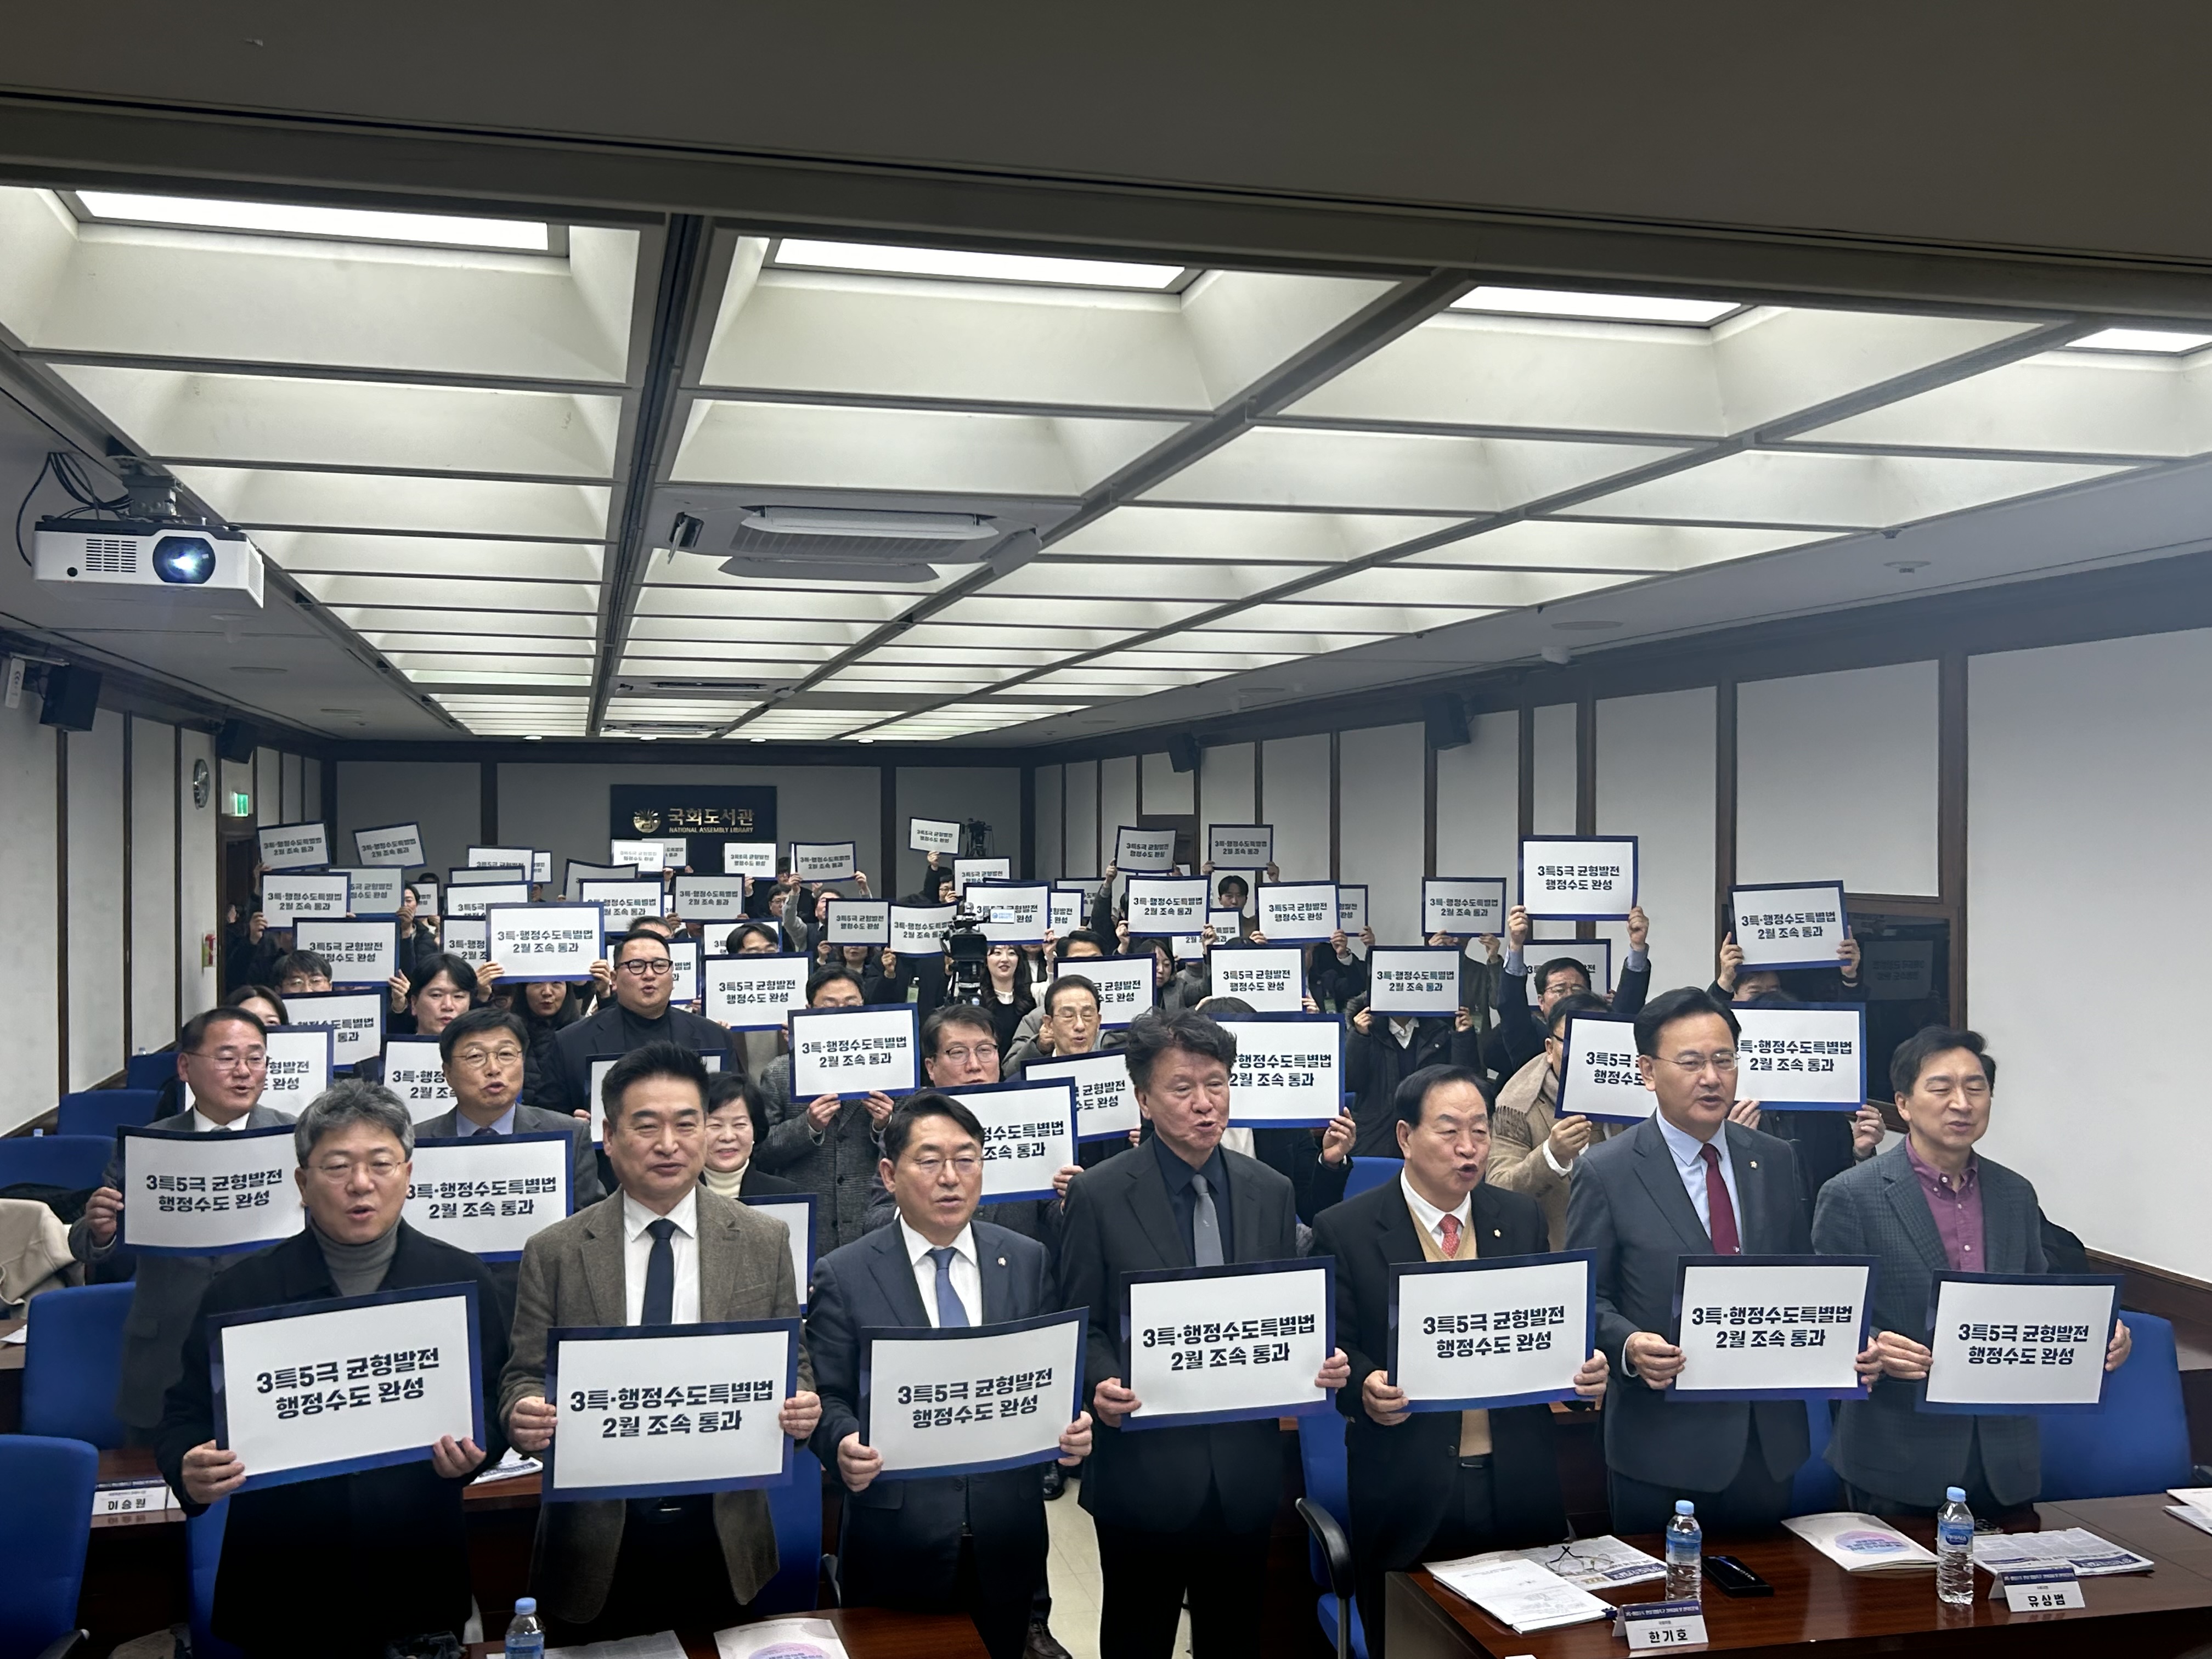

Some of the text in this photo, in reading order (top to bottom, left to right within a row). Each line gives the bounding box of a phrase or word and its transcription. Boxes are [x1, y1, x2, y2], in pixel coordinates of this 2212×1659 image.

[668, 809, 753, 826] 국회도서관
[1538, 865, 1620, 877] 3특5극 균형발전
[1545, 879, 1612, 890] 행정수도 완성
[1269, 902, 1327, 912] 3특5극 균형발전
[1441, 908, 1454, 916] 2월
[1473, 909, 1488, 917] 통과
[1017, 915, 1032, 923] 완성
[1274, 912, 1322, 922] 행정수도 완성
[1741, 911, 1836, 927] 3특·행정수도특별법
[1758, 926, 1823, 939] 2월 조속 통과
[309, 942, 382, 951] 3특5극 균형발전
[513, 943, 579, 953] 2월 조속 통과
[357, 953, 376, 962] 완성
[1223, 969, 1290, 980] 3특5극 균형발전
[719, 980, 795, 992] 3특5극 균형발전
[1105, 980, 1141, 991] 균형발전
[1230, 981, 1284, 992] 행정수도 완성
[1389, 983, 1443, 991] 2월 조속 통과
[727, 992, 788, 1005] 행정수도 완성
[1116, 992, 1134, 1002] 완성
[802, 1036, 907, 1054] 3특·행정수도특별법
[269, 1060, 309, 1075] 형발전
[820, 1052, 891, 1068] 2월 조속 통과
[1586, 1052, 1631, 1068] 3특5극
[1750, 1058, 1834, 1072] 2월 조속 통과
[273, 1077, 299, 1090] 완성
[1229, 1073, 1314, 1087] 2월 조속 통과
[410, 1087, 432, 1099] 2월
[1083, 1080, 1125, 1096] 균형발전
[1097, 1095, 1118, 1108] 완성
[983, 1142, 1046, 1160] 조속 통과
[146, 1169, 282, 1192] 3특5극 균형발전
[159, 1190, 269, 1212] 행정수도 완성
[429, 1199, 534, 1219] 2월 조속 통과
[1423, 1306, 1564, 1335] 3특5극 균형발전
[1692, 1306, 1853, 1325] 3특·행정수도특별법
[1143, 1314, 1314, 1348] 3특·행정수도특별법
[1716, 1329, 1825, 1348] 2월 조속 통과
[1959, 1324, 2089, 1342] 3특5극 균형발전
[1437, 1331, 1551, 1358] 행정수도 완성
[1171, 1342, 1290, 1371] 2월 조속 통과
[1968, 1346, 2074, 1365] 행정수도 완성
[257, 1347, 439, 1393] 3특5극 균형발전
[898, 1368, 1052, 1404] 3특5극 균형발전
[276, 1377, 424, 1419] 행정수도 완성
[571, 1380, 773, 1412] 3특·행정수도특별법
[913, 1395, 1037, 1429] 행정수도 완성
[602, 1410, 742, 1438] 2월 조속 통과
[2028, 1594, 2066, 1607] 유상범
[1649, 1629, 1688, 1643] 한기호
